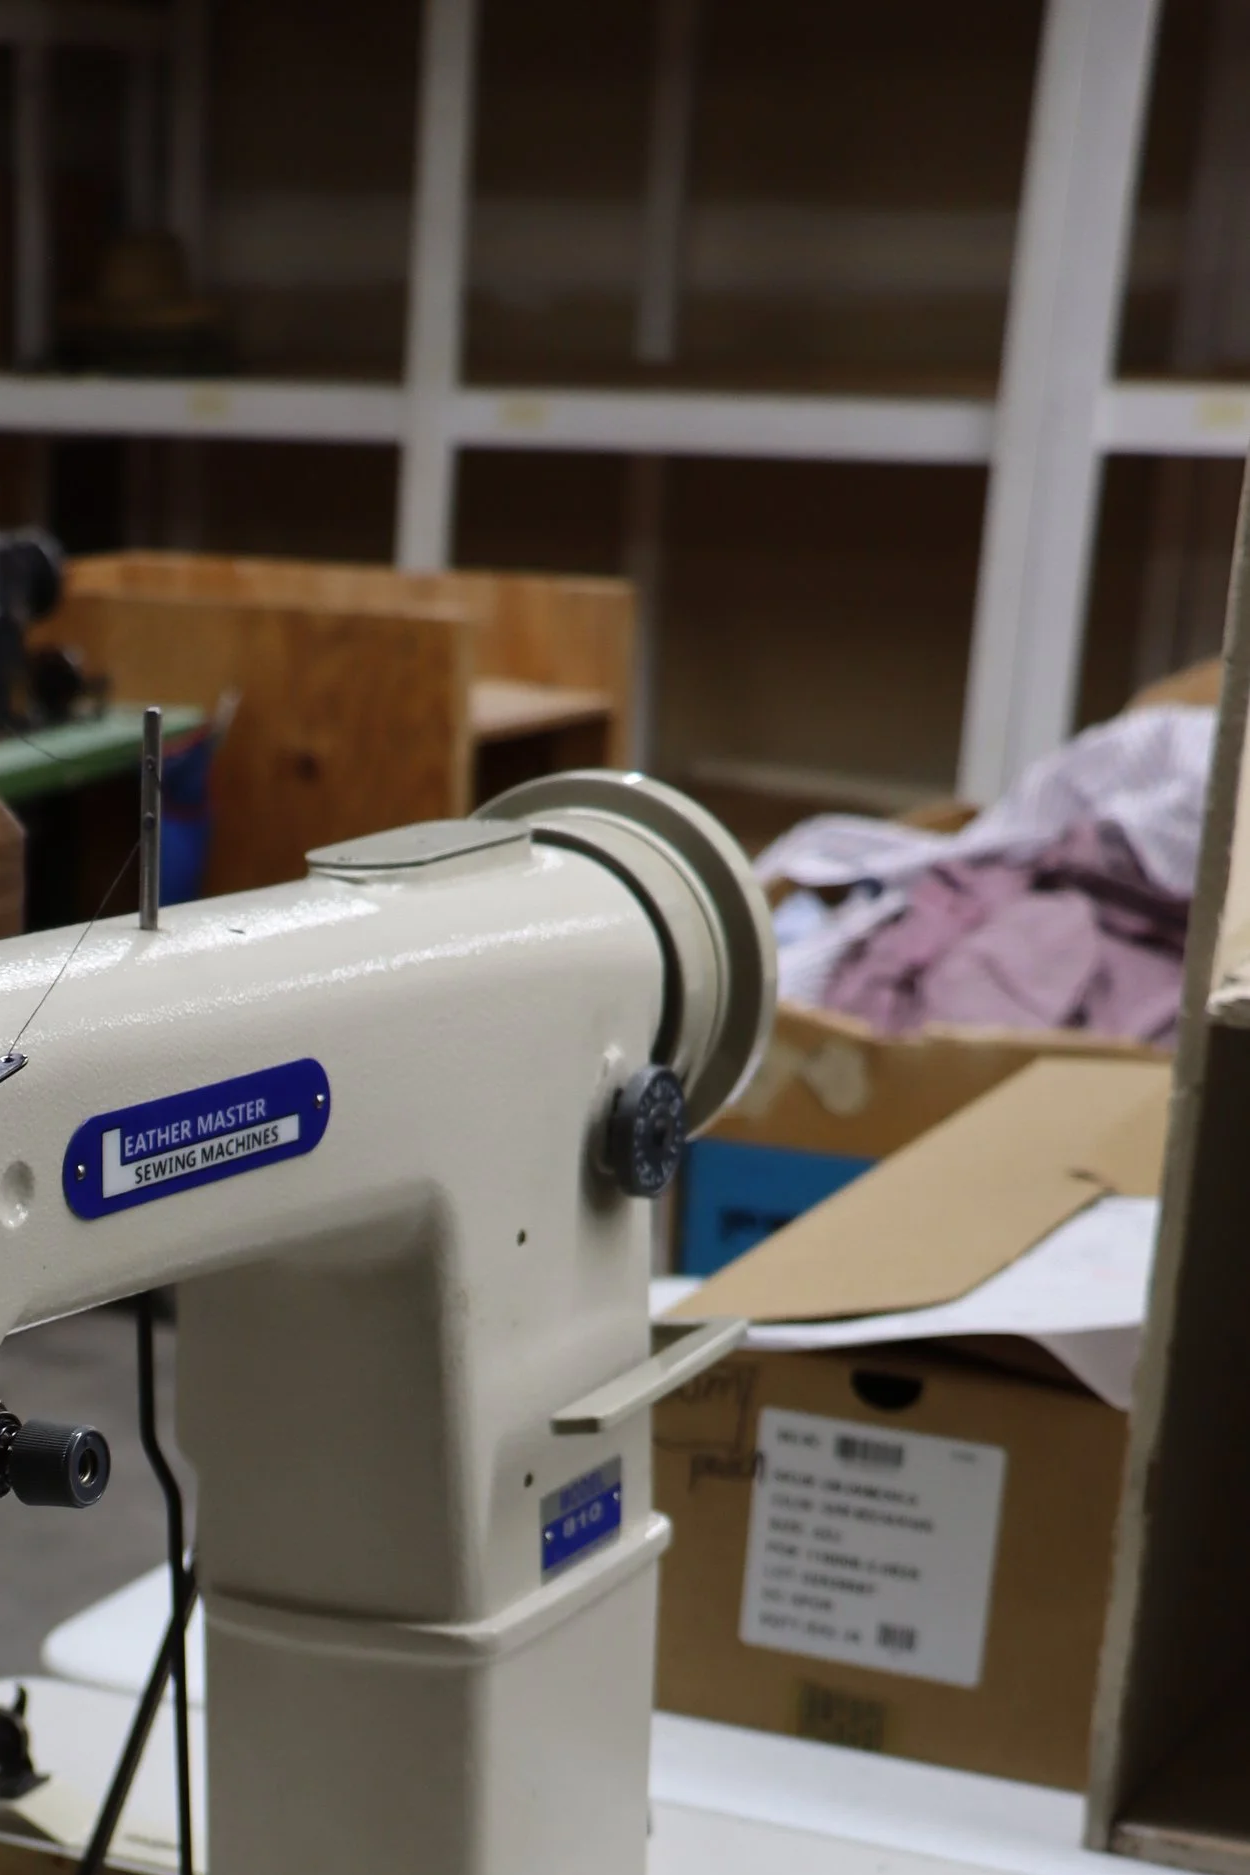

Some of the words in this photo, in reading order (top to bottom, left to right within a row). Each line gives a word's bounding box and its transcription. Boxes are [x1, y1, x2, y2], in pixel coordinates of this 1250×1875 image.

[197, 1098, 266, 1136] MASTER
[134, 1151, 197, 1184] SEWING
[200, 1125, 280, 1164] MACHINES
